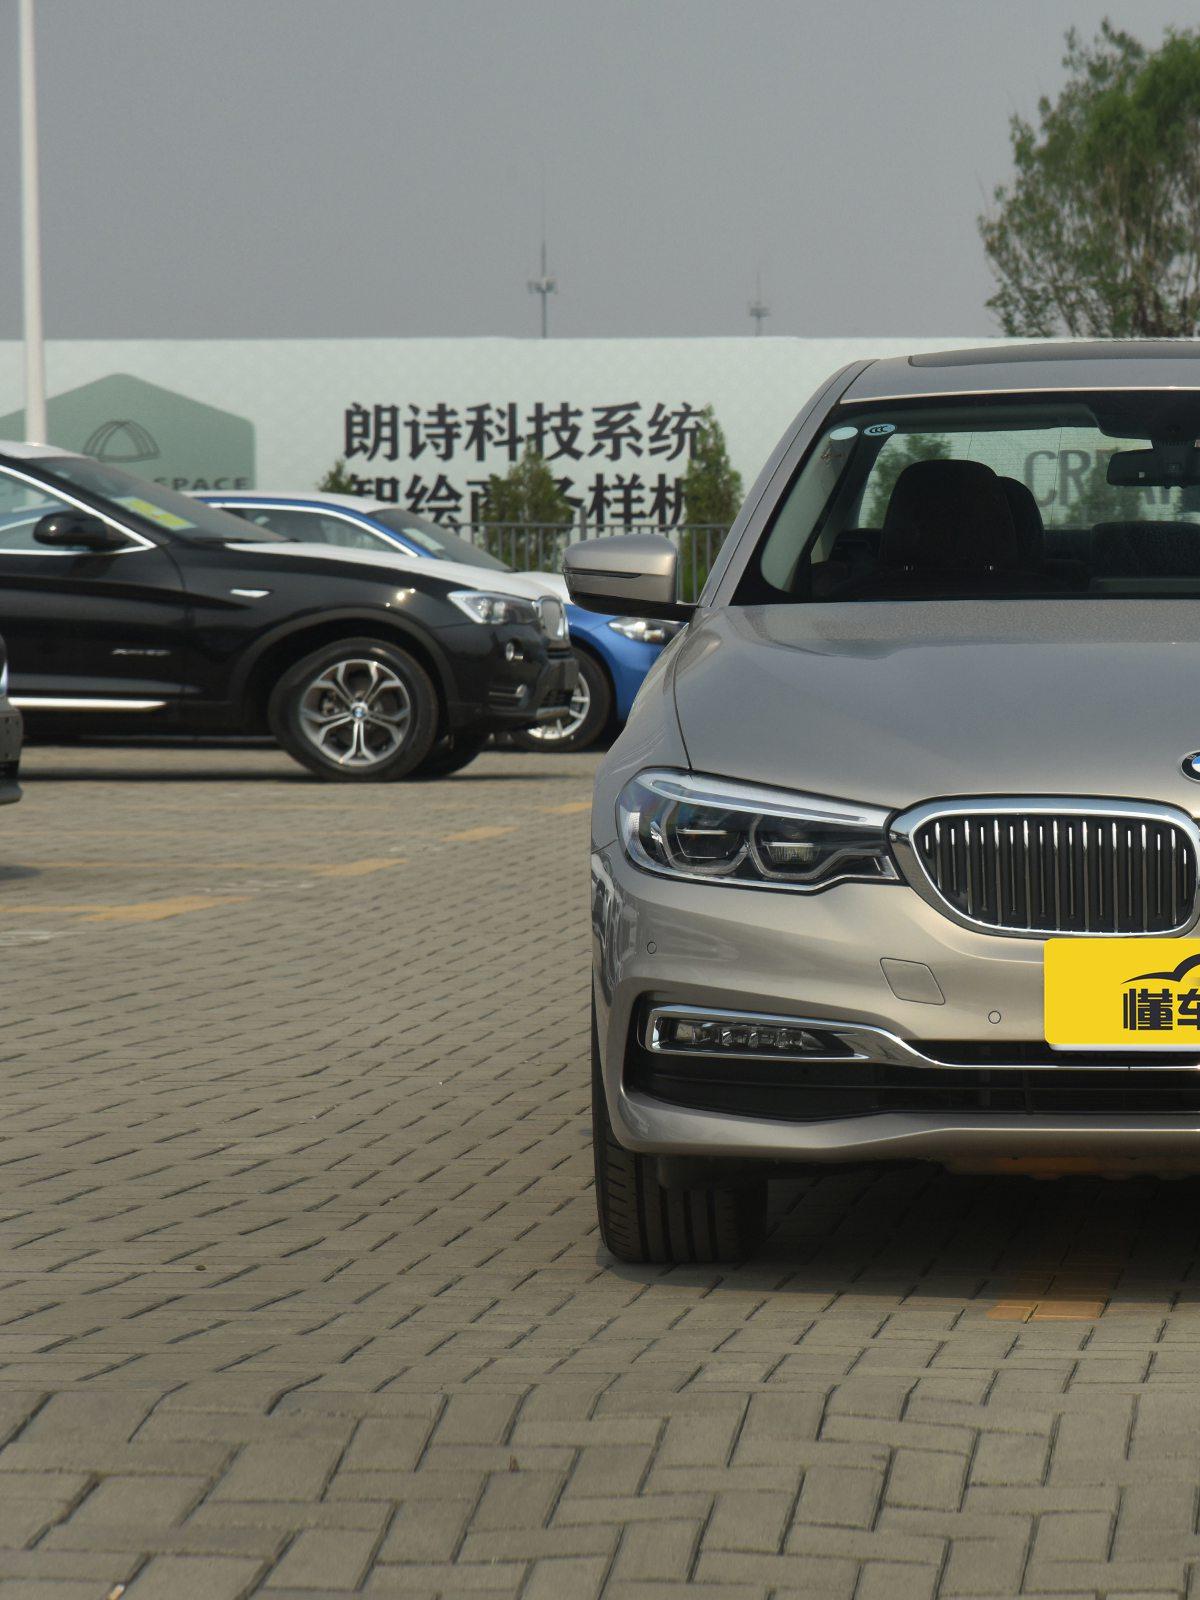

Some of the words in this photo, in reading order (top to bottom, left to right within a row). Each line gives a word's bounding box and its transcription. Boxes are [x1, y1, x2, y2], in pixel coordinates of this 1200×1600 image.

[344, 401, 704, 462] 朗诗科技系统
